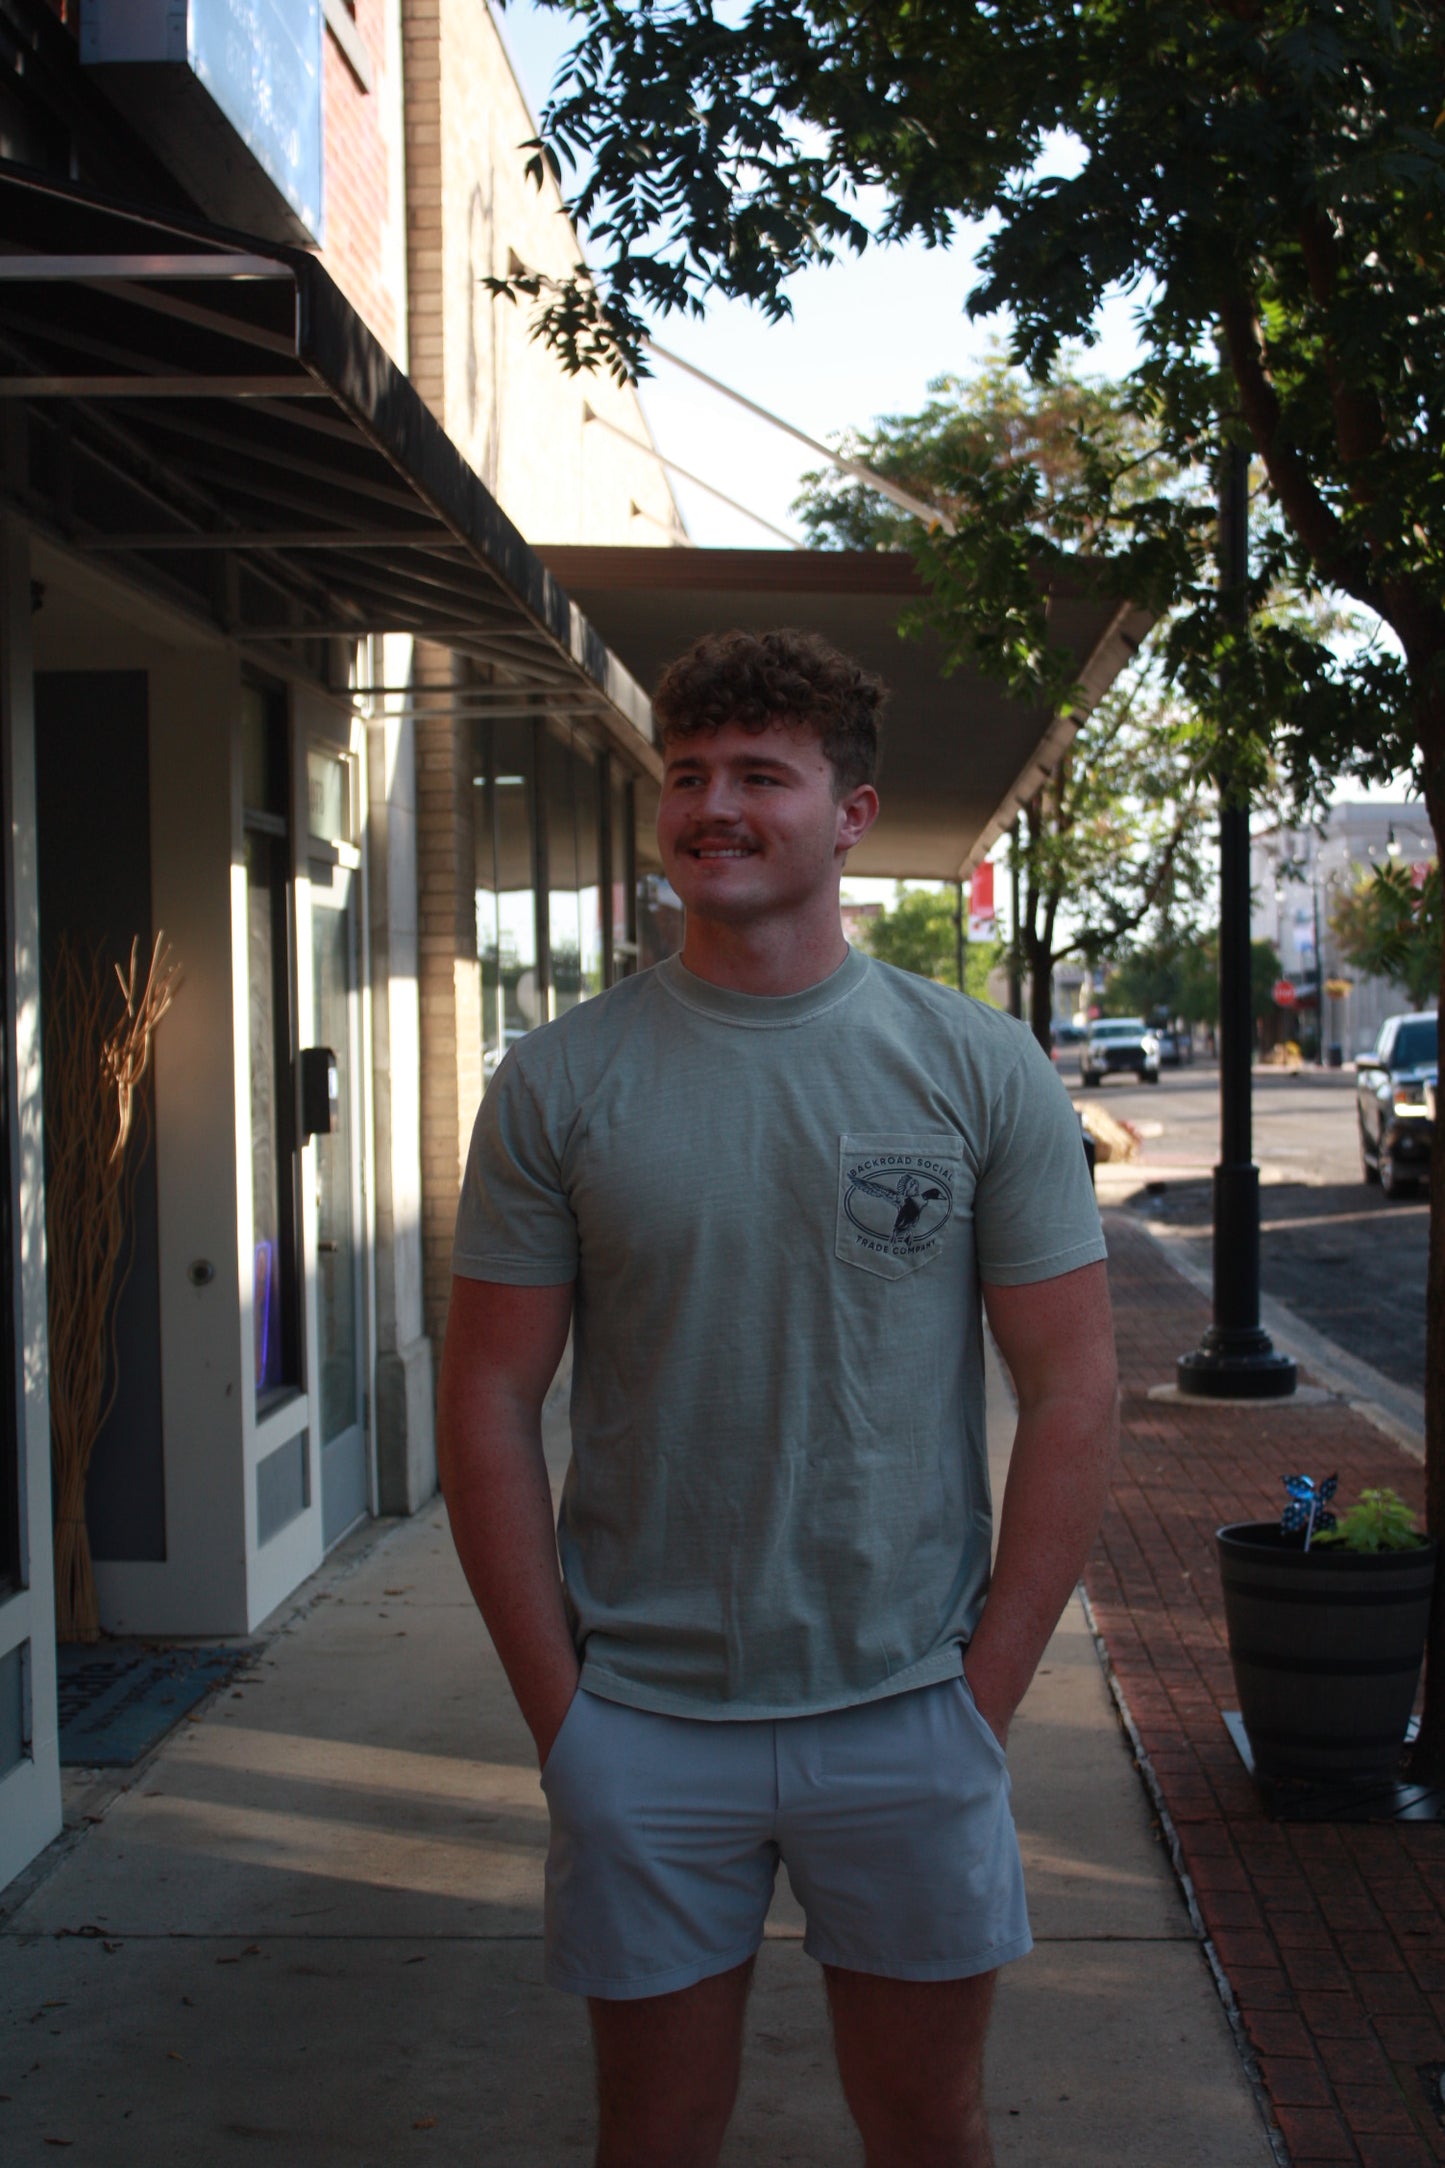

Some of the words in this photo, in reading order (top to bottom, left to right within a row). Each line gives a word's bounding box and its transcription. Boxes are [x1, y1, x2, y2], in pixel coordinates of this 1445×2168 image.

[849, 1156, 912, 1177] BACKROAD
[917, 1158, 953, 1181] SOCIAL
[856, 1235, 888, 1254] TRADE
[892, 1240, 936, 1255] COMPANY
